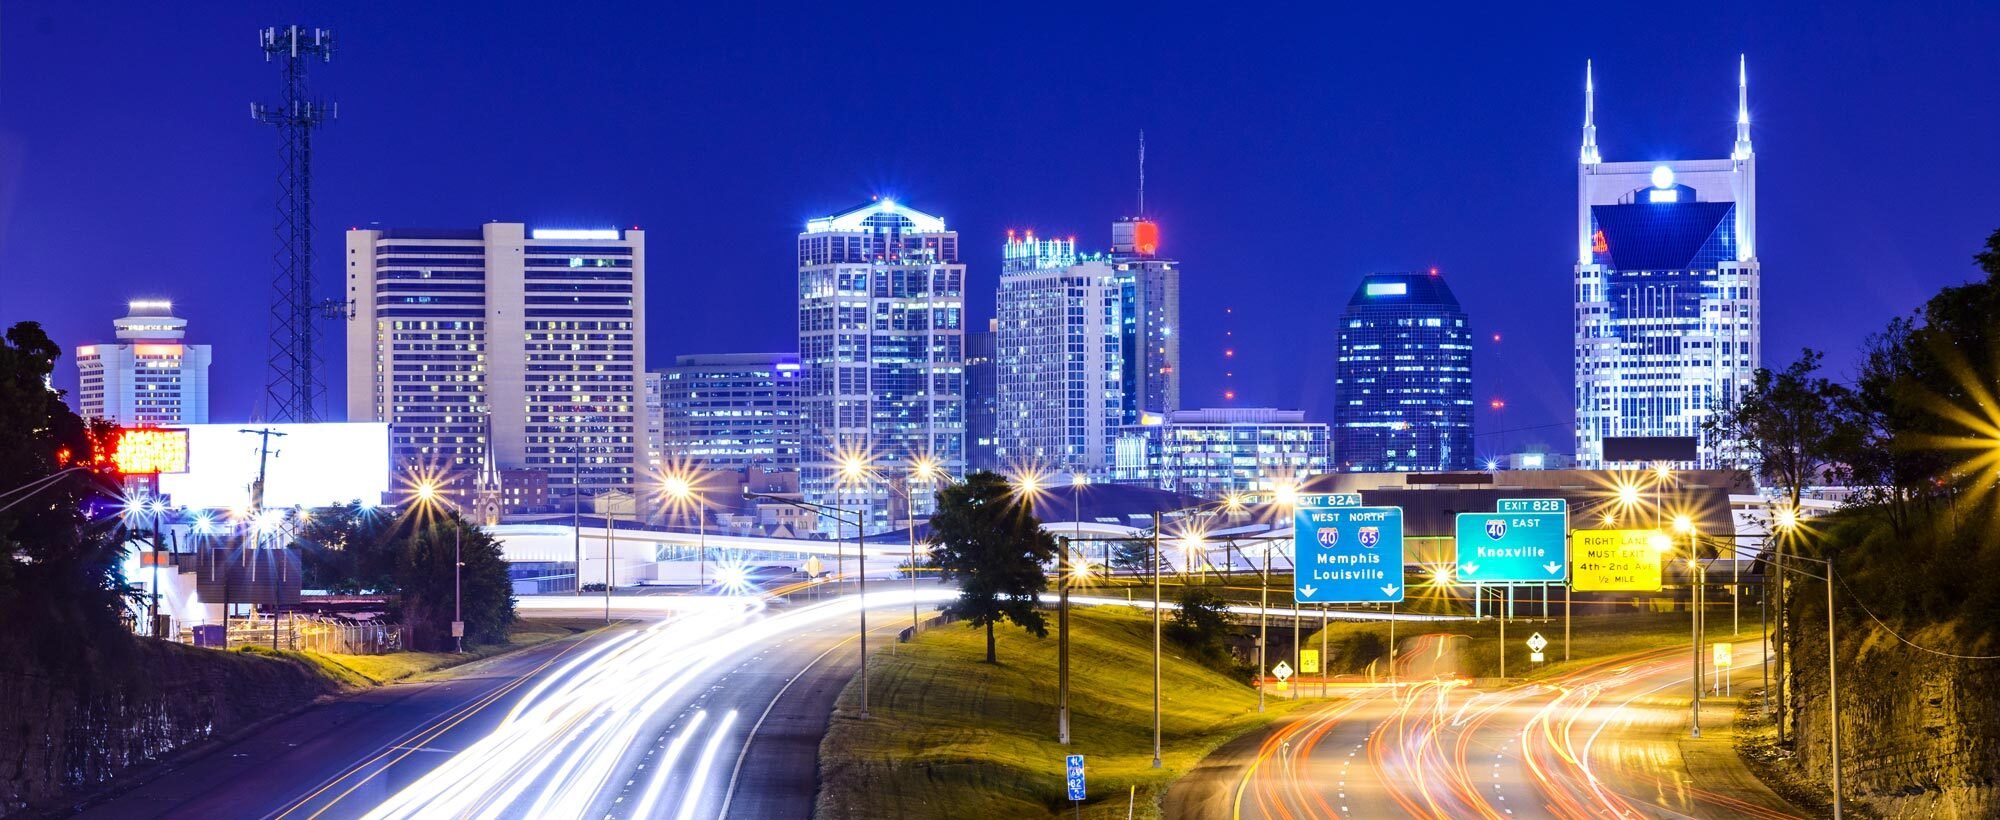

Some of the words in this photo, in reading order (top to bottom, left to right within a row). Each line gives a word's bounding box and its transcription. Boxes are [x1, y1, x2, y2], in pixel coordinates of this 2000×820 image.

[1299, 496, 1322, 505] EXIT
[1328, 496, 1355, 505] 82A
[1504, 501, 1528, 510] EXIT
[1533, 501, 1559, 511] 82B
[1312, 513, 1340, 522] WEST
[1349, 513, 1385, 522] NORTH
[1512, 519, 1541, 528] EAST
[1488, 523, 1504, 536] 40
[1320, 533, 1336, 545] 40
[1361, 532, 1376, 545] 65
[1584, 537, 1614, 545] RIGHT
[1621, 536, 1648, 545] LANE
[1477, 546, 1545, 558] Knoxville
[1588, 550, 1616, 558] MUST
[1622, 550, 1645, 558] EXIT
[1317, 553, 1380, 566] Memphis
[1313, 569, 1384, 580] Louisville
[1615, 575, 1636, 583] MILE
[1070, 779, 1081, 788] 82
